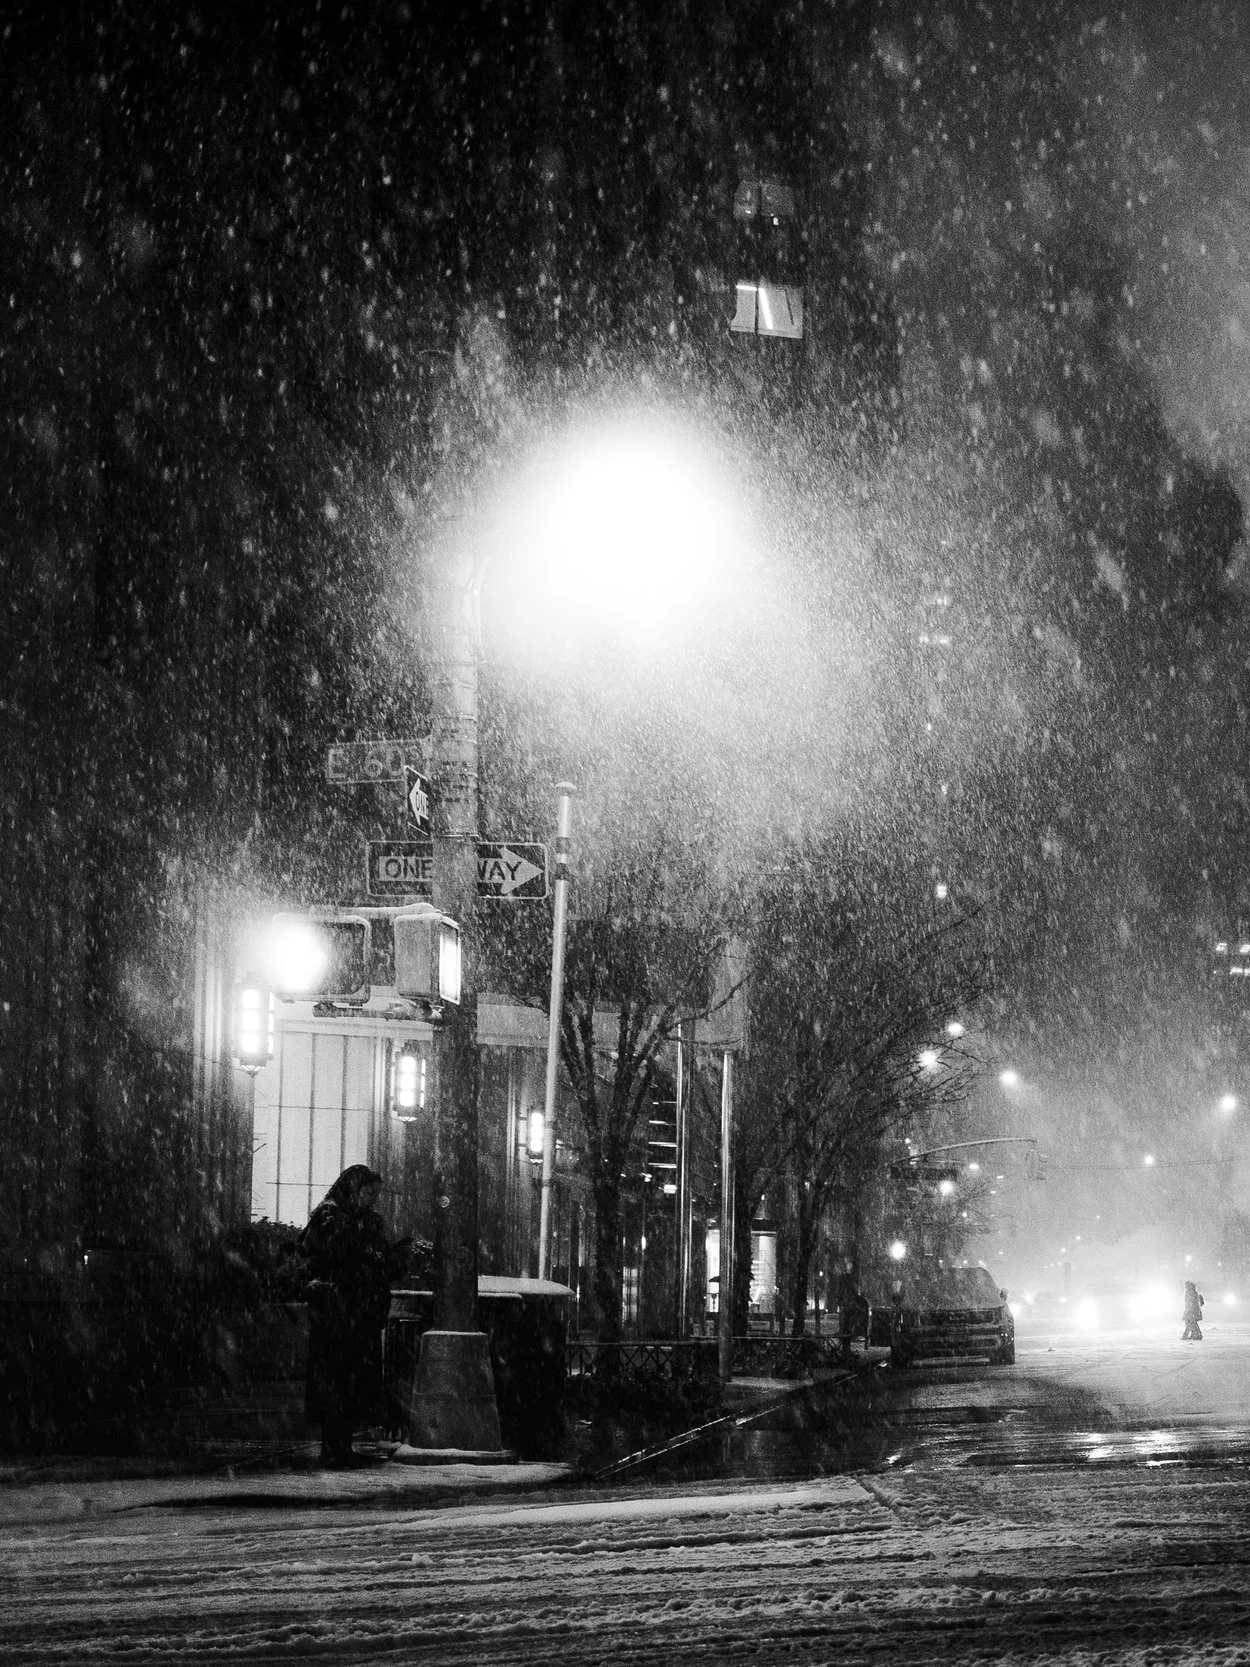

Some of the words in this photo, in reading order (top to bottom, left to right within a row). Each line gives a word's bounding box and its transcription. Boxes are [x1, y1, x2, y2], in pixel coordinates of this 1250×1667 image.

[327, 748, 347, 778] E
[364, 748, 404, 778] 60
[385, 858, 433, 879] ONE
